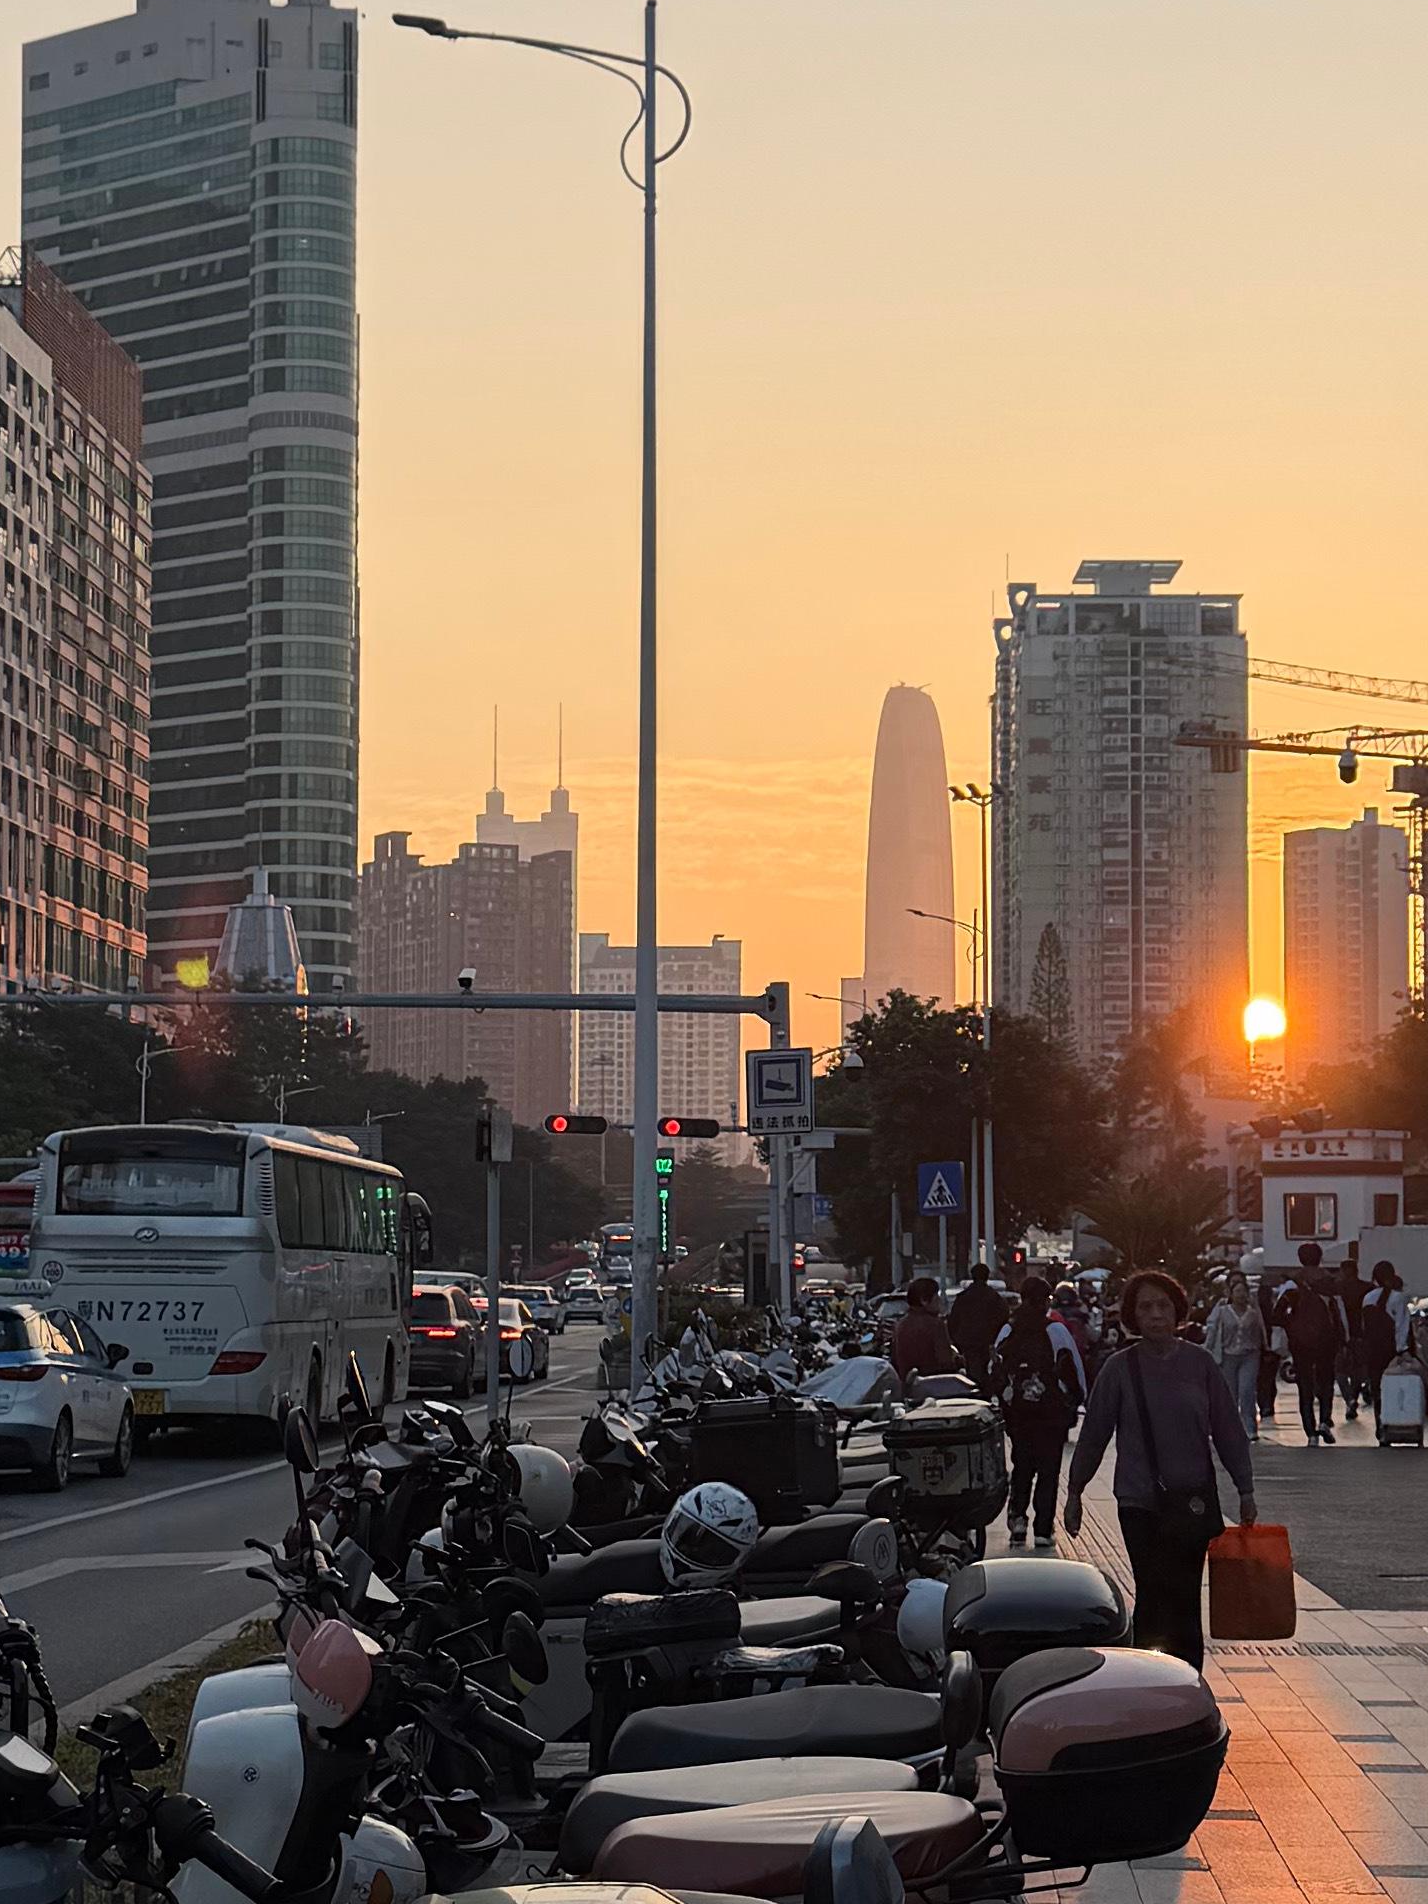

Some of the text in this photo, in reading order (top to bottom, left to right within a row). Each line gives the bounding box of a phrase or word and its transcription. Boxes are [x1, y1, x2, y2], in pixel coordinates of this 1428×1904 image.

[751, 1115, 810, 1129] 违法抓拍
[13, 1280, 43, 1292] TAXI
[78, 1300, 205, 1322] 粤N72737
